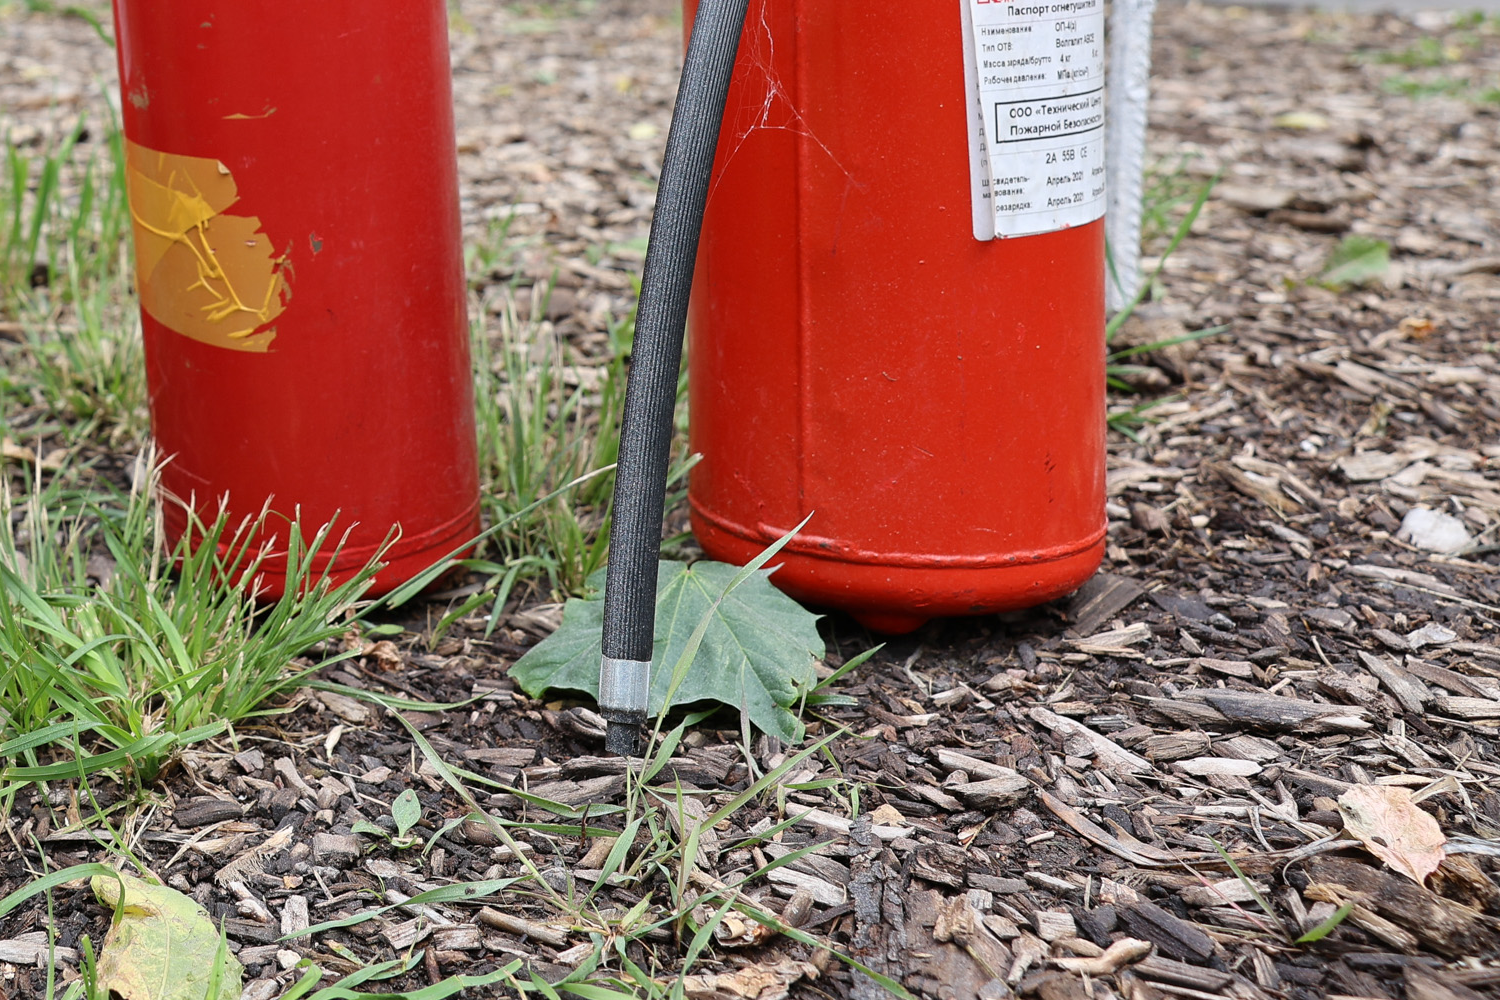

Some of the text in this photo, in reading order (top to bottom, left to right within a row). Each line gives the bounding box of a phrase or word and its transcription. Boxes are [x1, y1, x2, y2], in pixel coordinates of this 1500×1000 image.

[1008, 5, 1049, 17] Паспорт
[982, 44, 995, 53] Тип
[983, 60, 1005, 68] Масса
[1009, 107, 1032, 118] ООО
[1010, 121, 1060, 136] Пожарной
[1045, 152, 1057, 164] 2A
[1062, 149, 1075, 161] 55B
[1046, 175, 1070, 187] Апрель
[1047, 196, 1071, 208] Апрель
